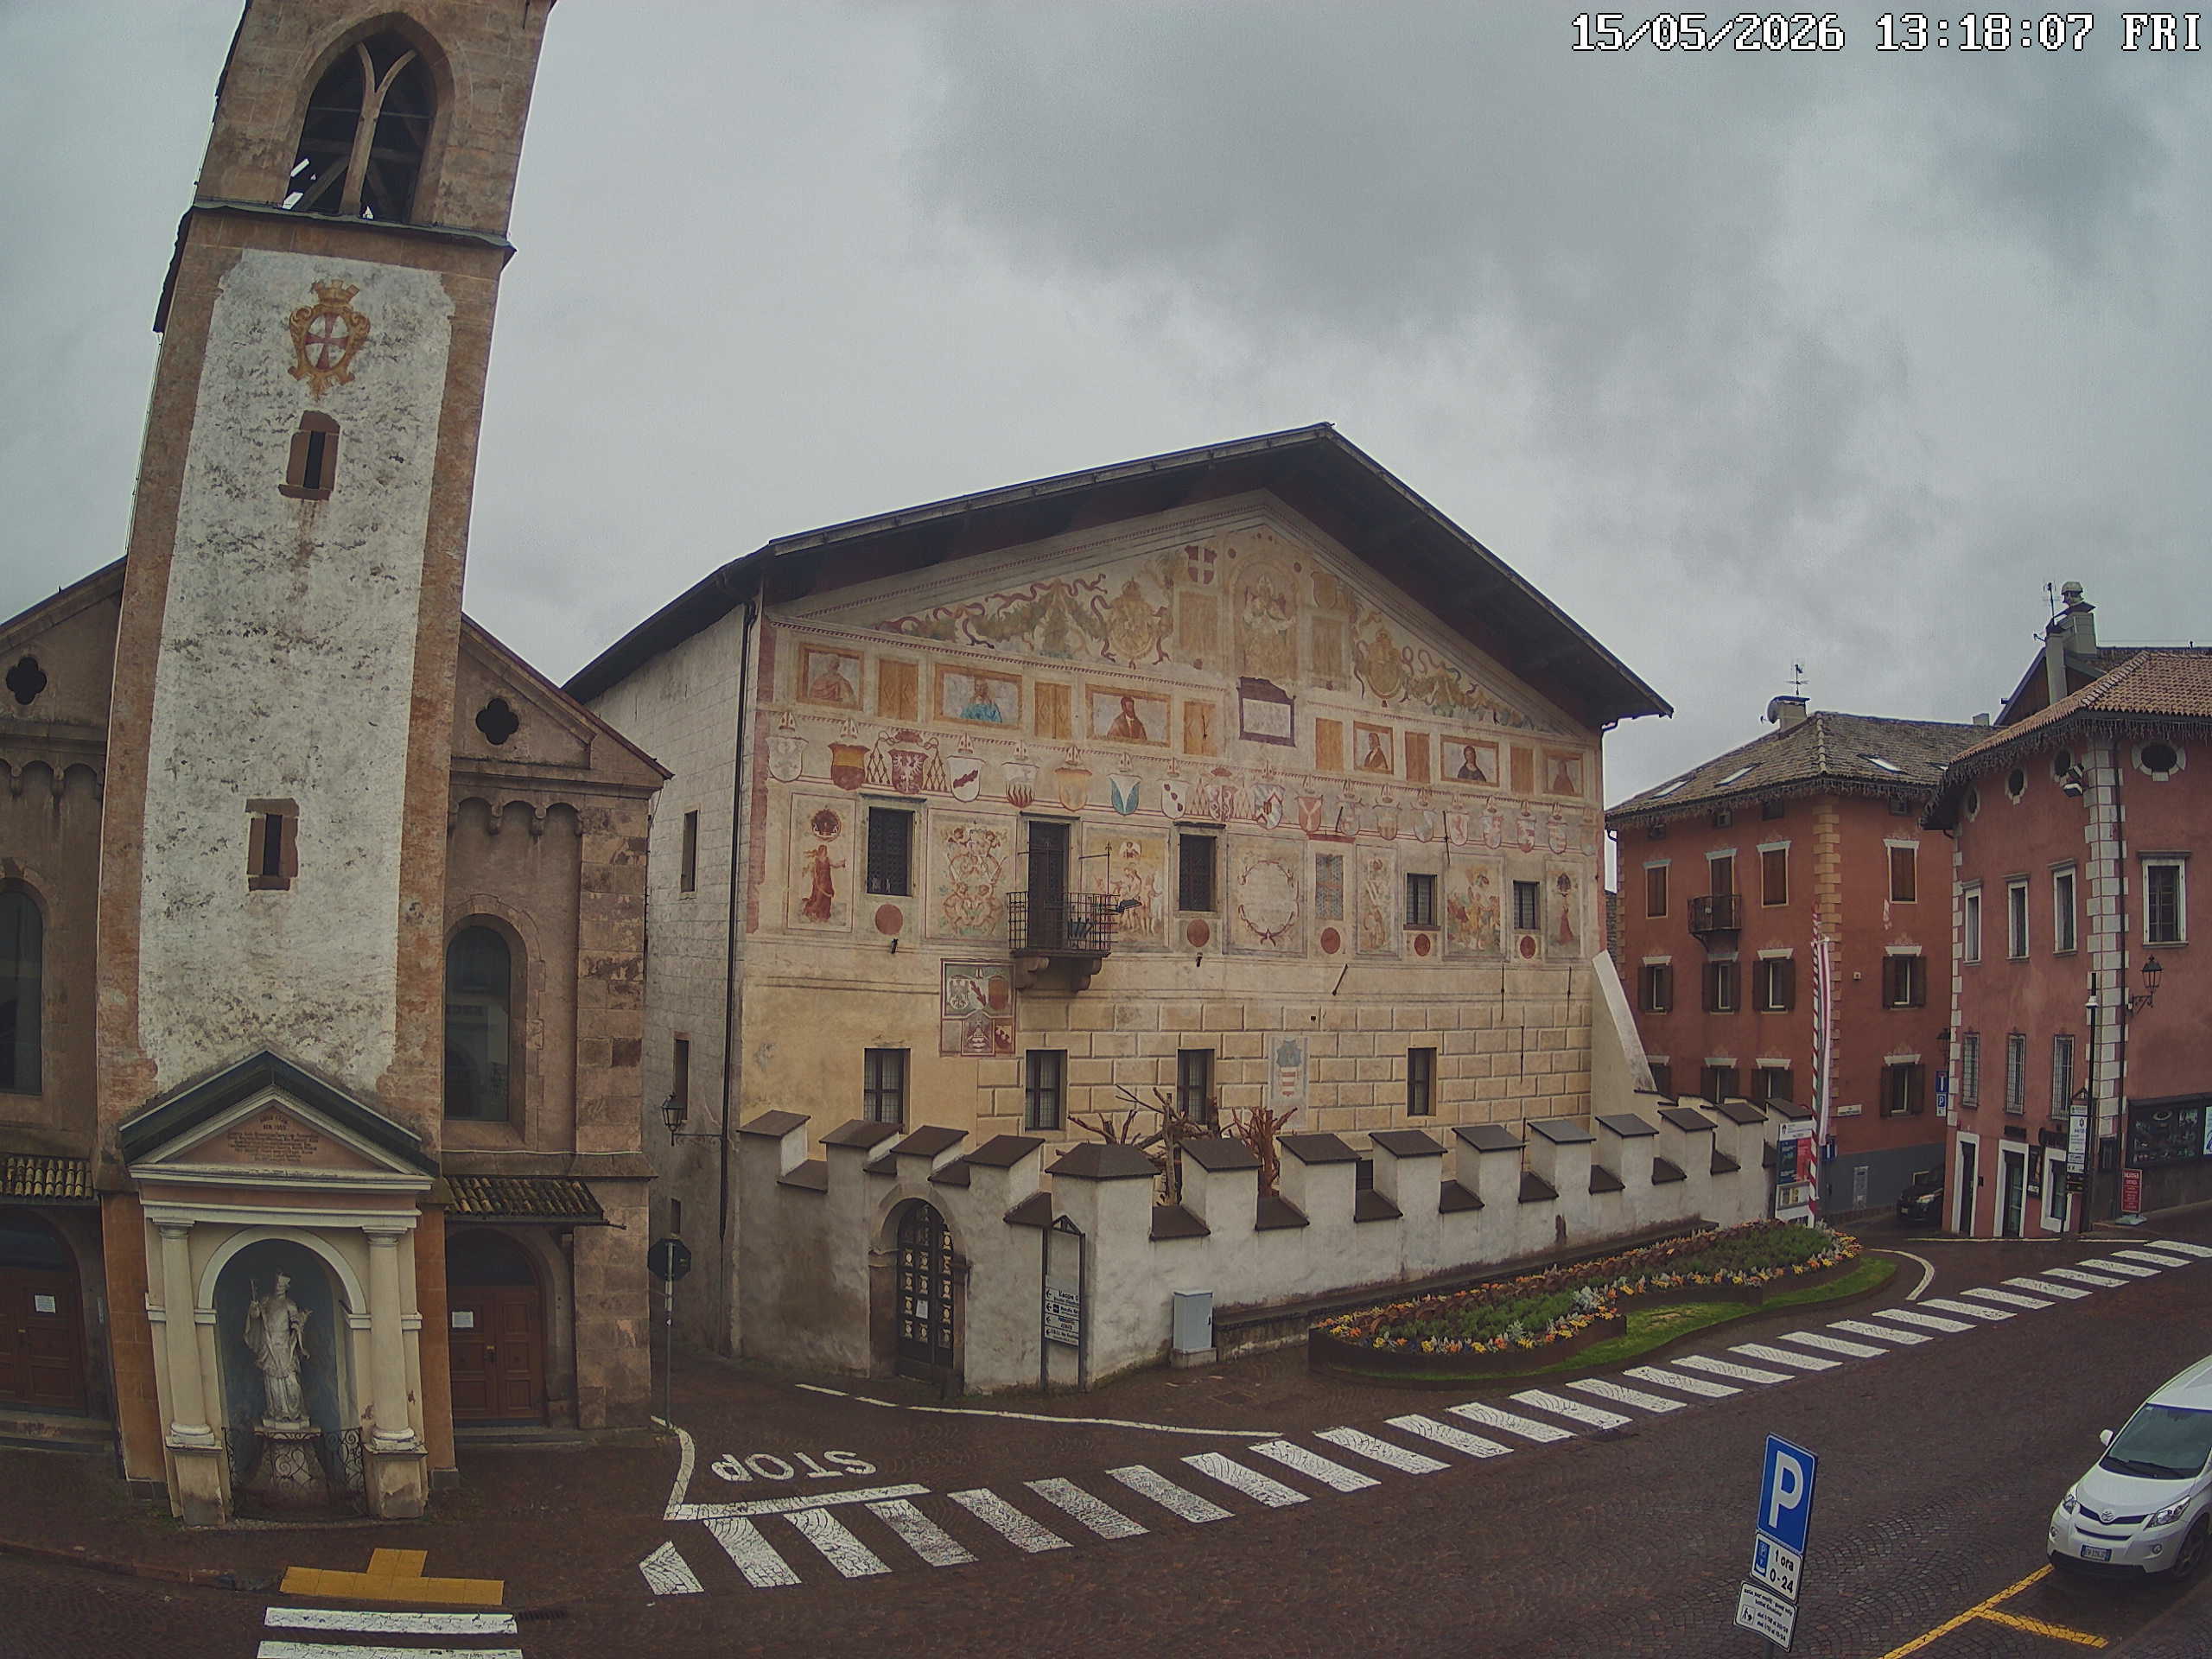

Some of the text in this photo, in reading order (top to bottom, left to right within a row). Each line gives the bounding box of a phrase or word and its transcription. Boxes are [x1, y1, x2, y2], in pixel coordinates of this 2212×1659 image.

[711, 1451, 877, 1482] STOP
[1768, 1450, 1804, 1529] P
[1775, 1548, 1794, 1572] 1 ora
